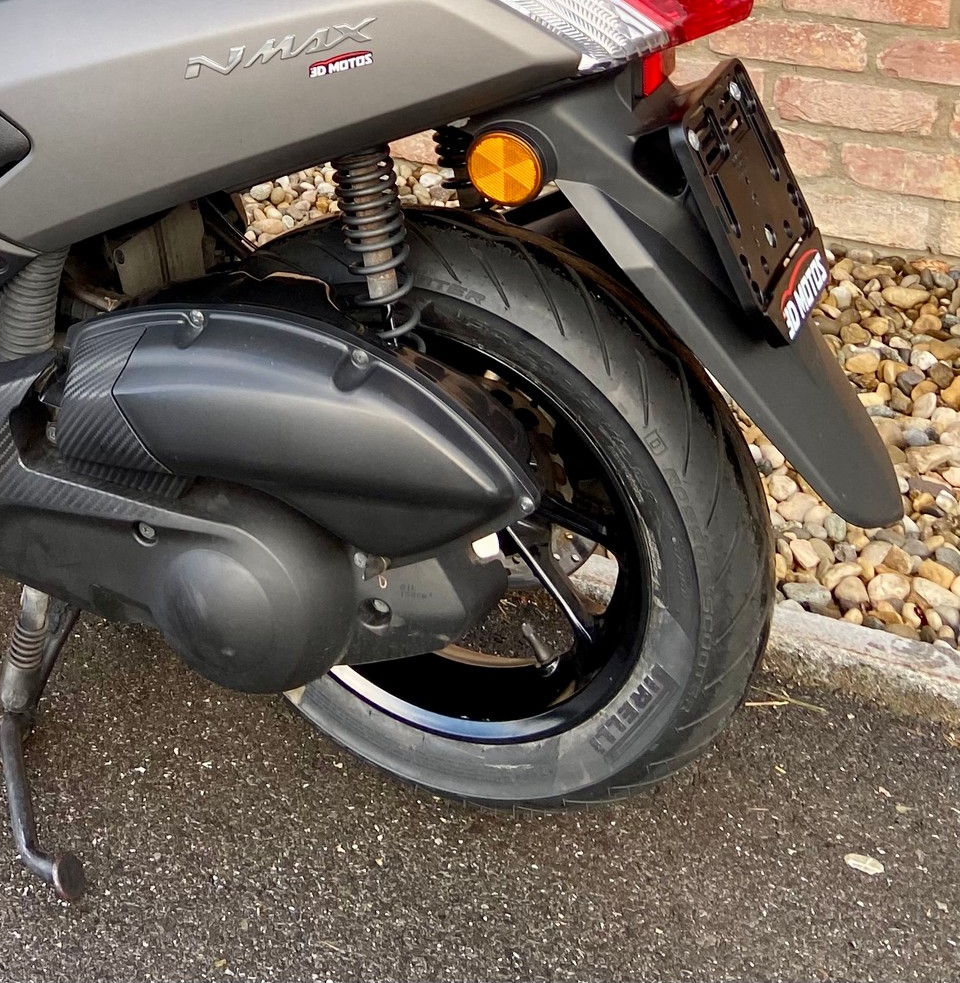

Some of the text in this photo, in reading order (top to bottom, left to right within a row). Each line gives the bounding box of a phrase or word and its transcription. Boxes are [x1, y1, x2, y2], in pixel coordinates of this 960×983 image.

[184, 16, 377, 79] NMAX
[310, 52, 373, 78] 3D MOTOS
[782, 251, 828, 341] 3D MOTOS
[589, 662, 680, 758] PIRELLI
